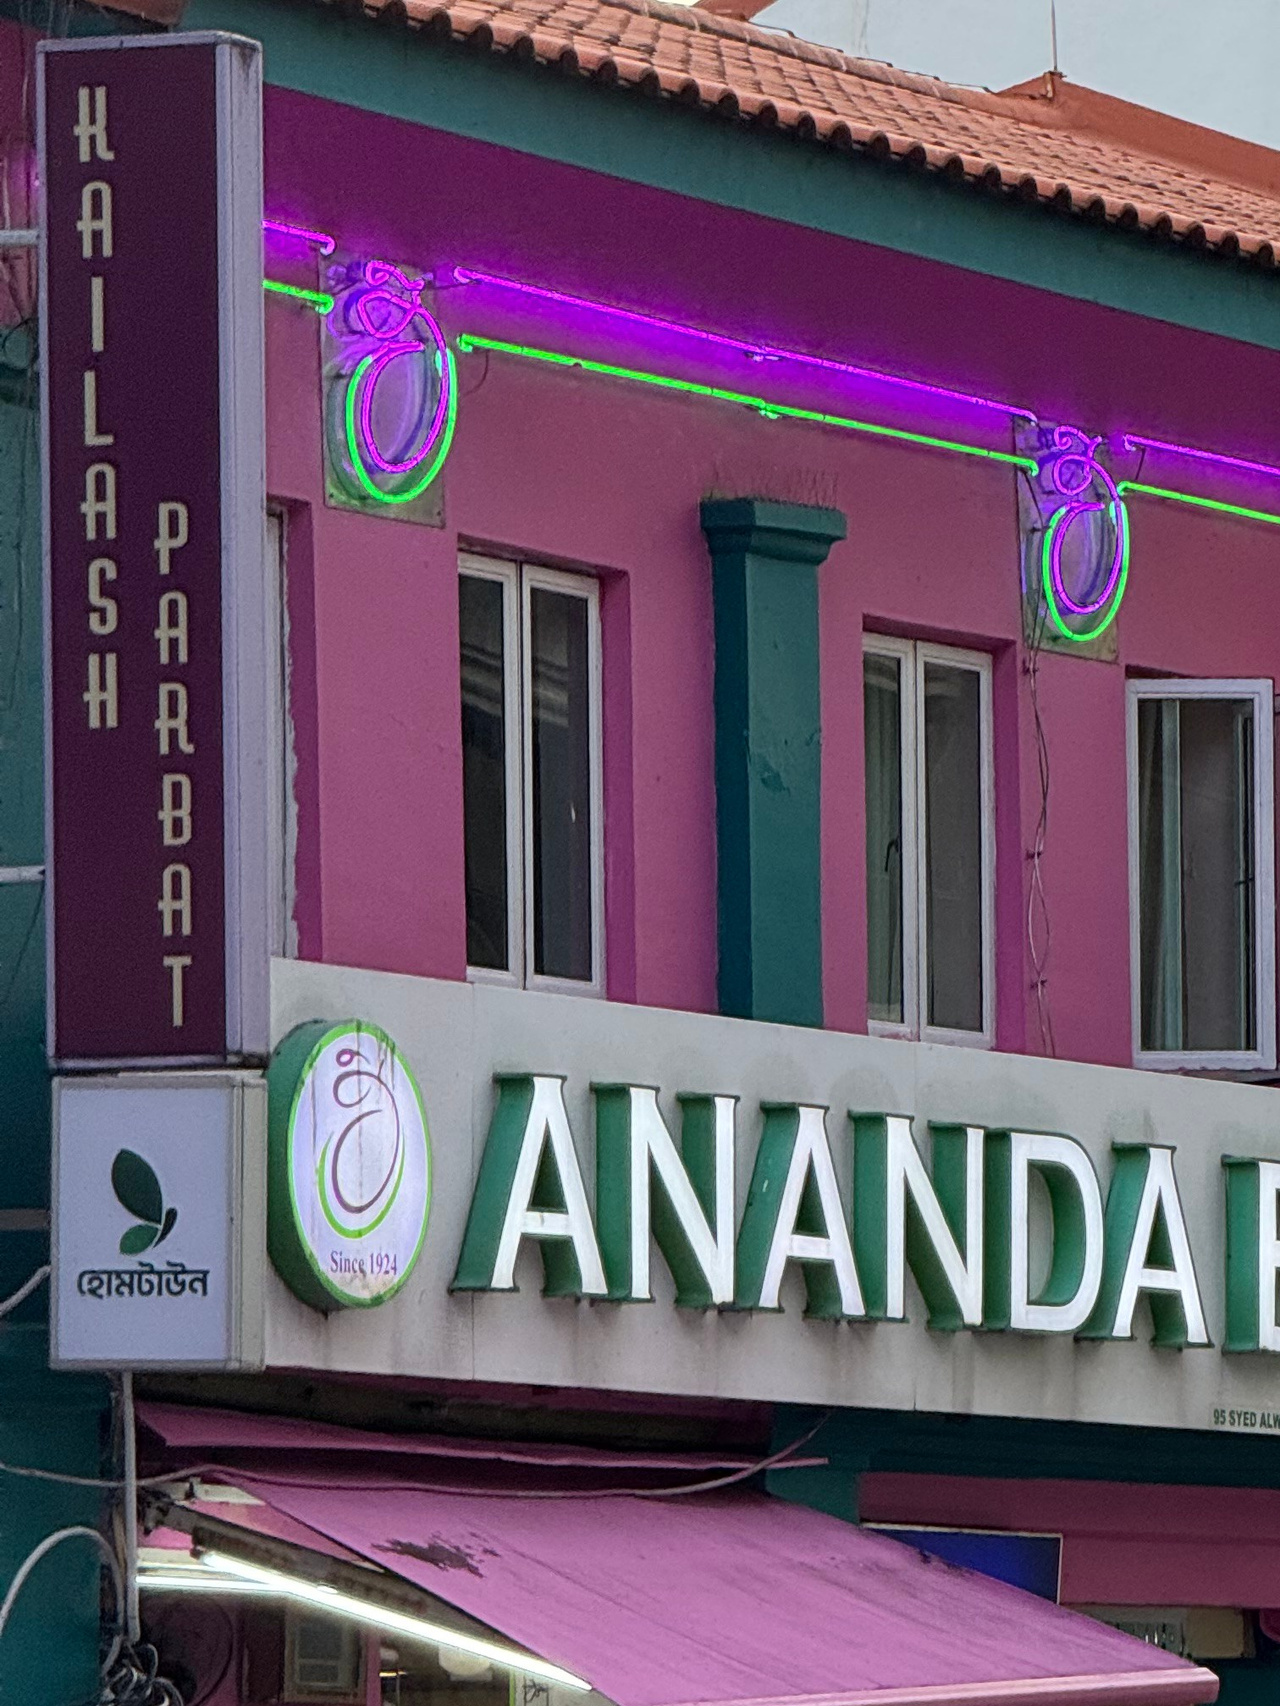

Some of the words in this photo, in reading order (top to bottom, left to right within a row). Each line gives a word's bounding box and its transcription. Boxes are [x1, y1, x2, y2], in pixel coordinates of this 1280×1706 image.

[73, 86, 119, 730] KAILASH
[154, 501, 194, 1028] PARBAT
[77, 1260, 210, 1300] হোমটাউন
[330, 1250, 365, 1274] Since
[370, 1252, 397, 1275] 1924
[456, 1074, 1213, 1349] ANANDA
[1213, 1408, 1226, 1425] 95
[1229, 1410, 1257, 1427] SYED
